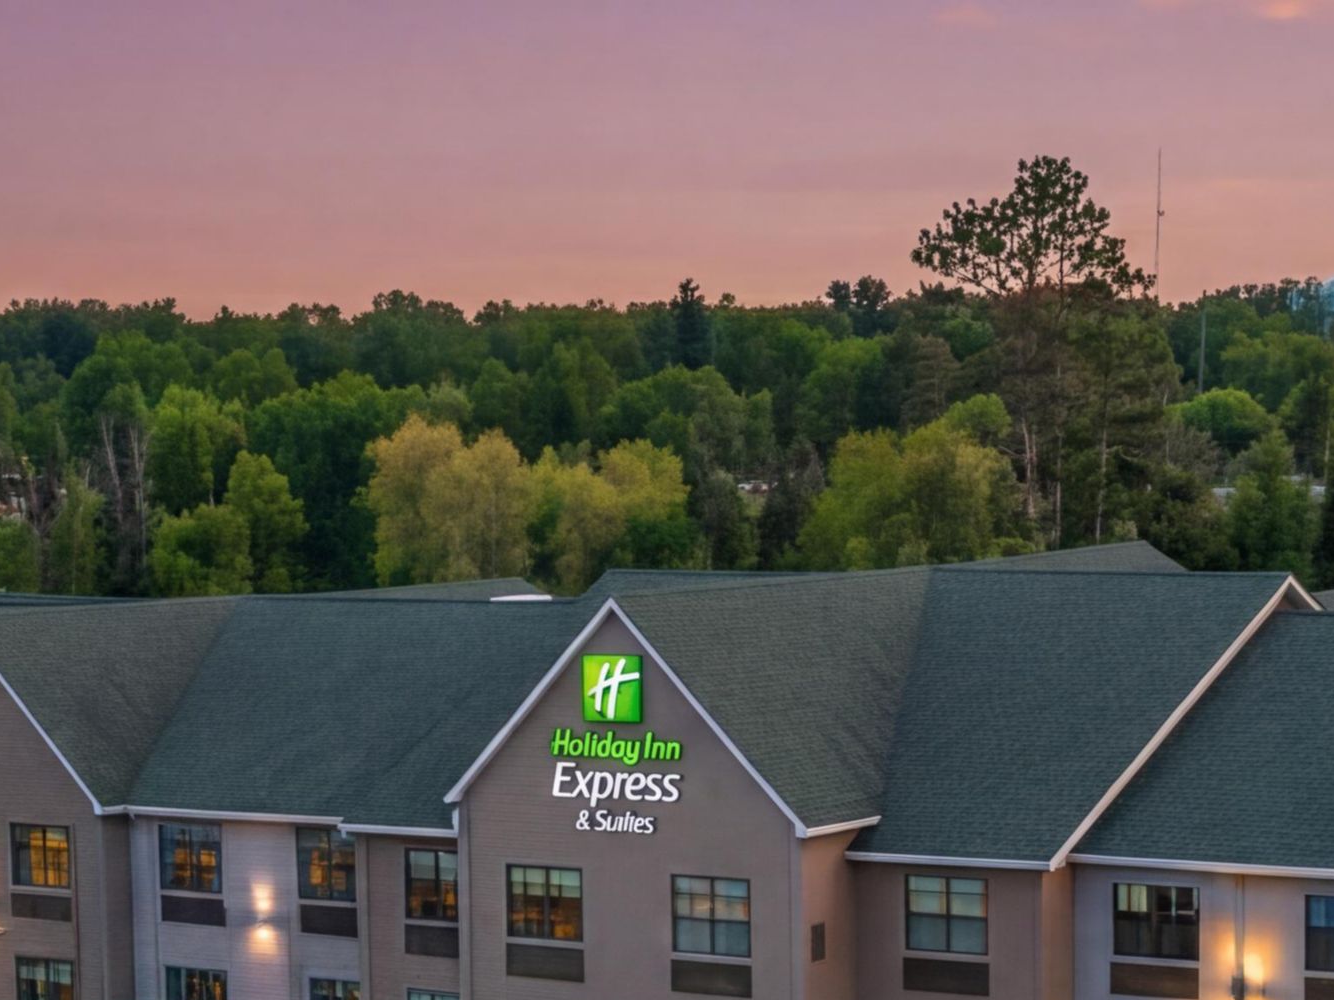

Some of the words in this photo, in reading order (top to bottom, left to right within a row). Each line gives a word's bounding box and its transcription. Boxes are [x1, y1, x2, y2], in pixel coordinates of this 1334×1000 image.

[552, 729, 639, 765] Holiday
[643, 731, 681, 760] Inn
[552, 761, 681, 807] Express
[575, 809, 591, 831] &
